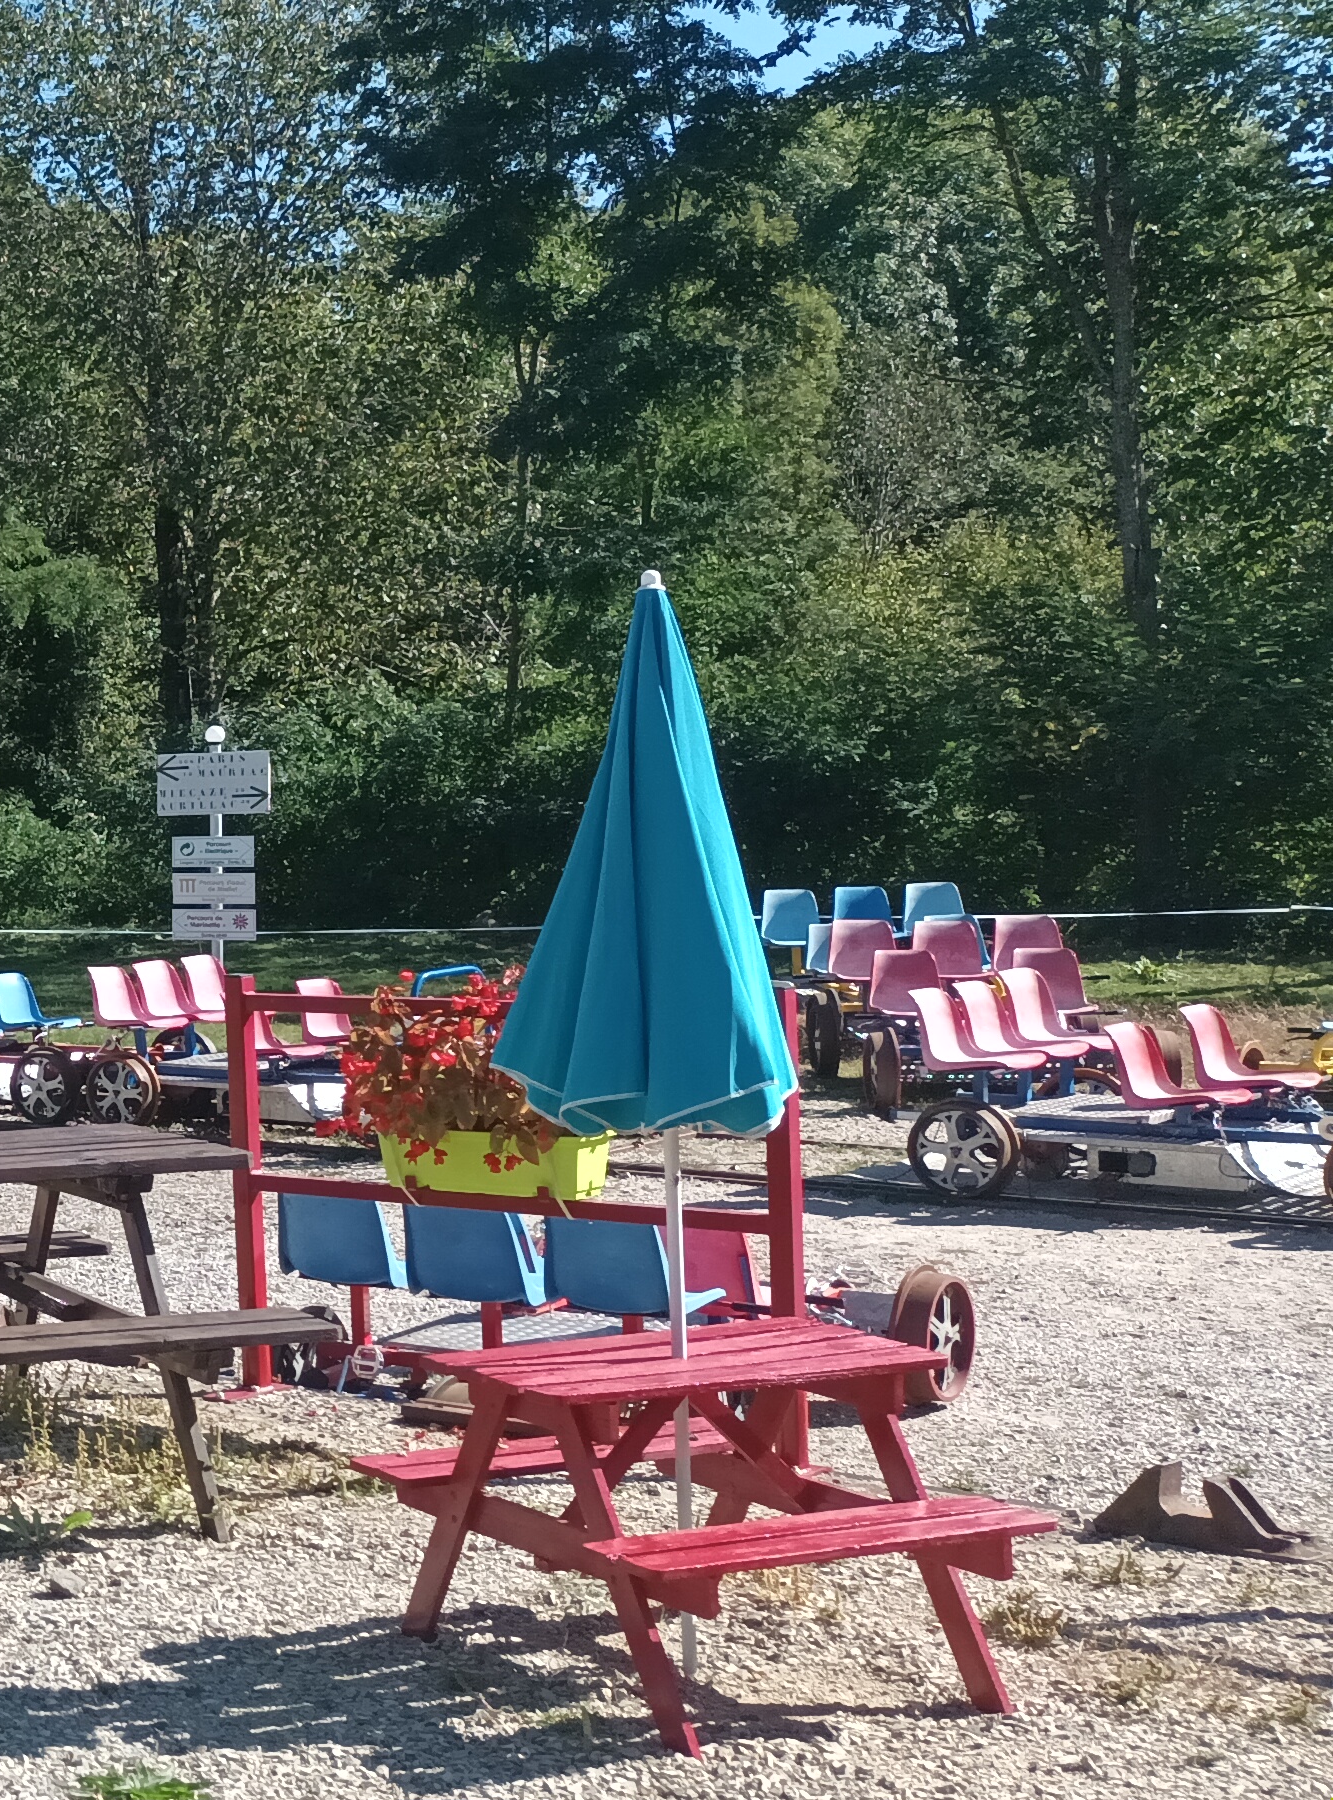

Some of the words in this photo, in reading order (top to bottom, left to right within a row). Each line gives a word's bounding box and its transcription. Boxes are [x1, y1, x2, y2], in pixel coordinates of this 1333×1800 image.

[197, 754, 246, 764] PARIS
[197, 767, 268, 777] MAURIAC
[159, 799, 238, 811] AURILLAC
